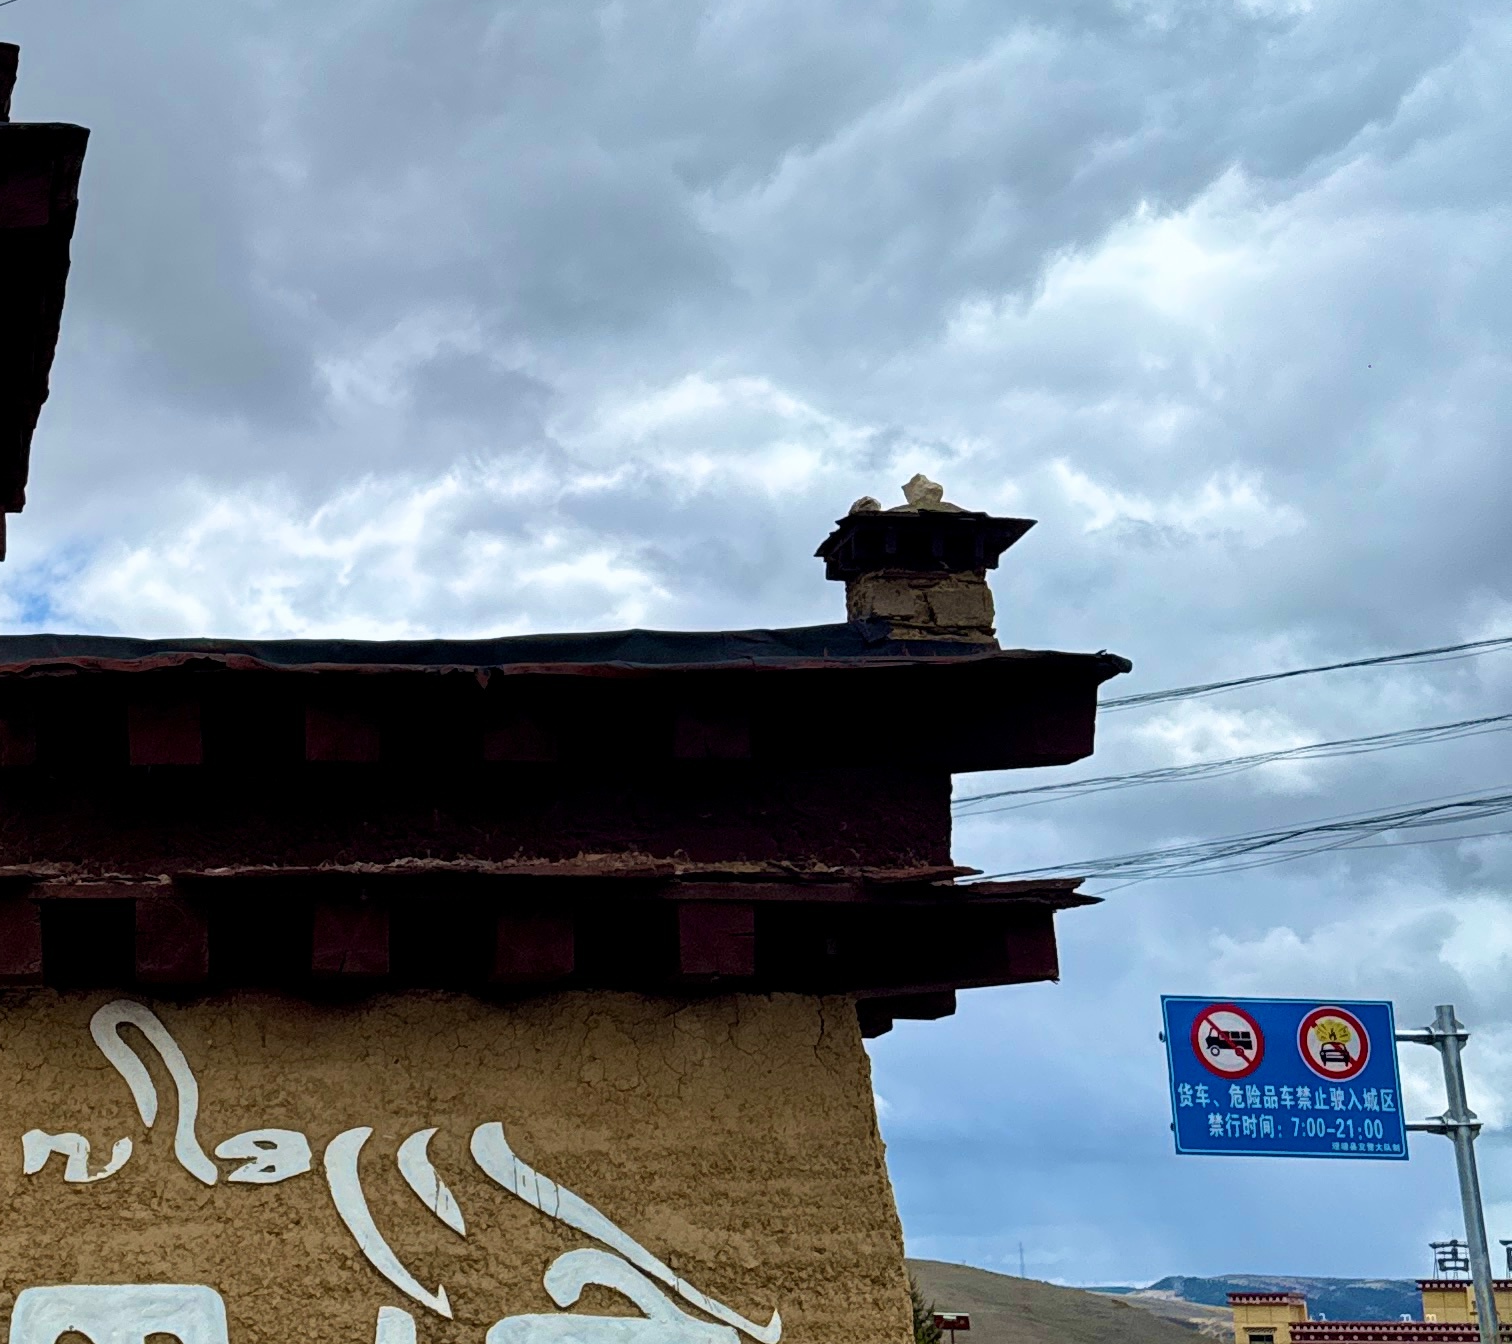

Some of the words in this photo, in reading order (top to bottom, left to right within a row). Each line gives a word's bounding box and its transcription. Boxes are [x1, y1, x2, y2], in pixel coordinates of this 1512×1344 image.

[1177, 1082, 1397, 1113] 货车、危险品车禁止驶入城区
[1290, 1116, 1384, 1141] 7:00-21:00
